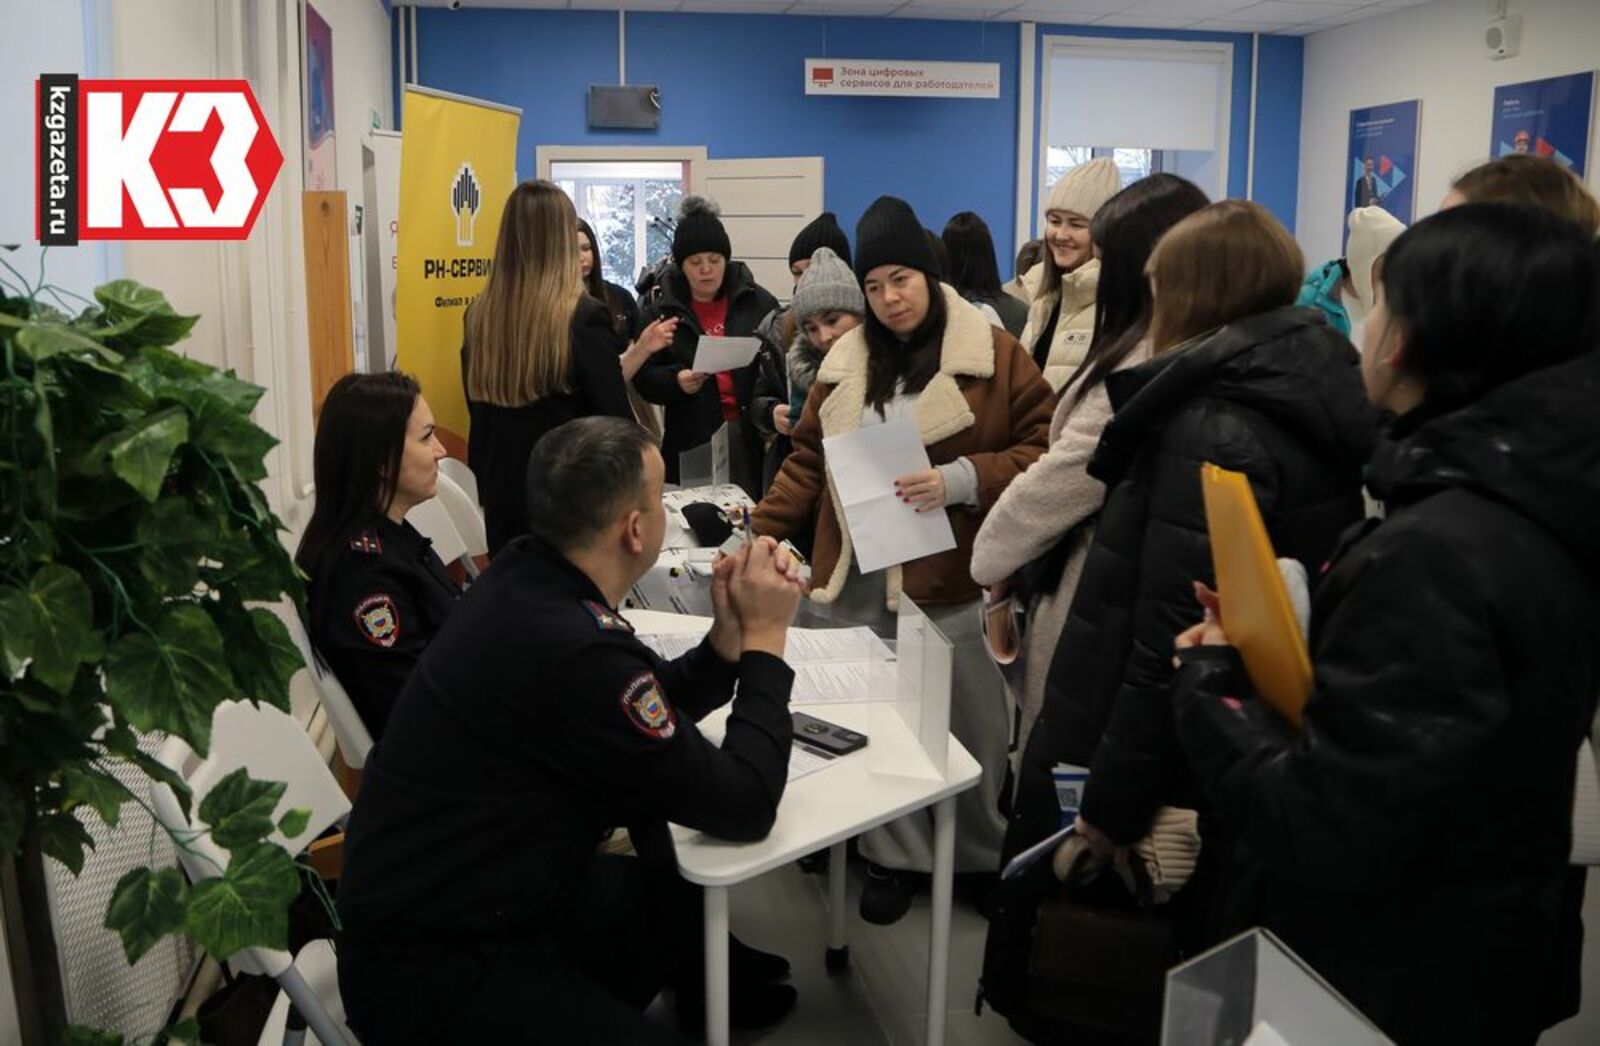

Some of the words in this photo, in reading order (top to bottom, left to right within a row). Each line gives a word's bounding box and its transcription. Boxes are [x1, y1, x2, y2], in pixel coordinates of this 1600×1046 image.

[840, 66, 866, 77] Зона
[868, 67, 924, 79] цифровых
[840, 79, 891, 89] сервисов
[893, 80, 912, 90] для
[915, 80, 994, 91] работодателей
